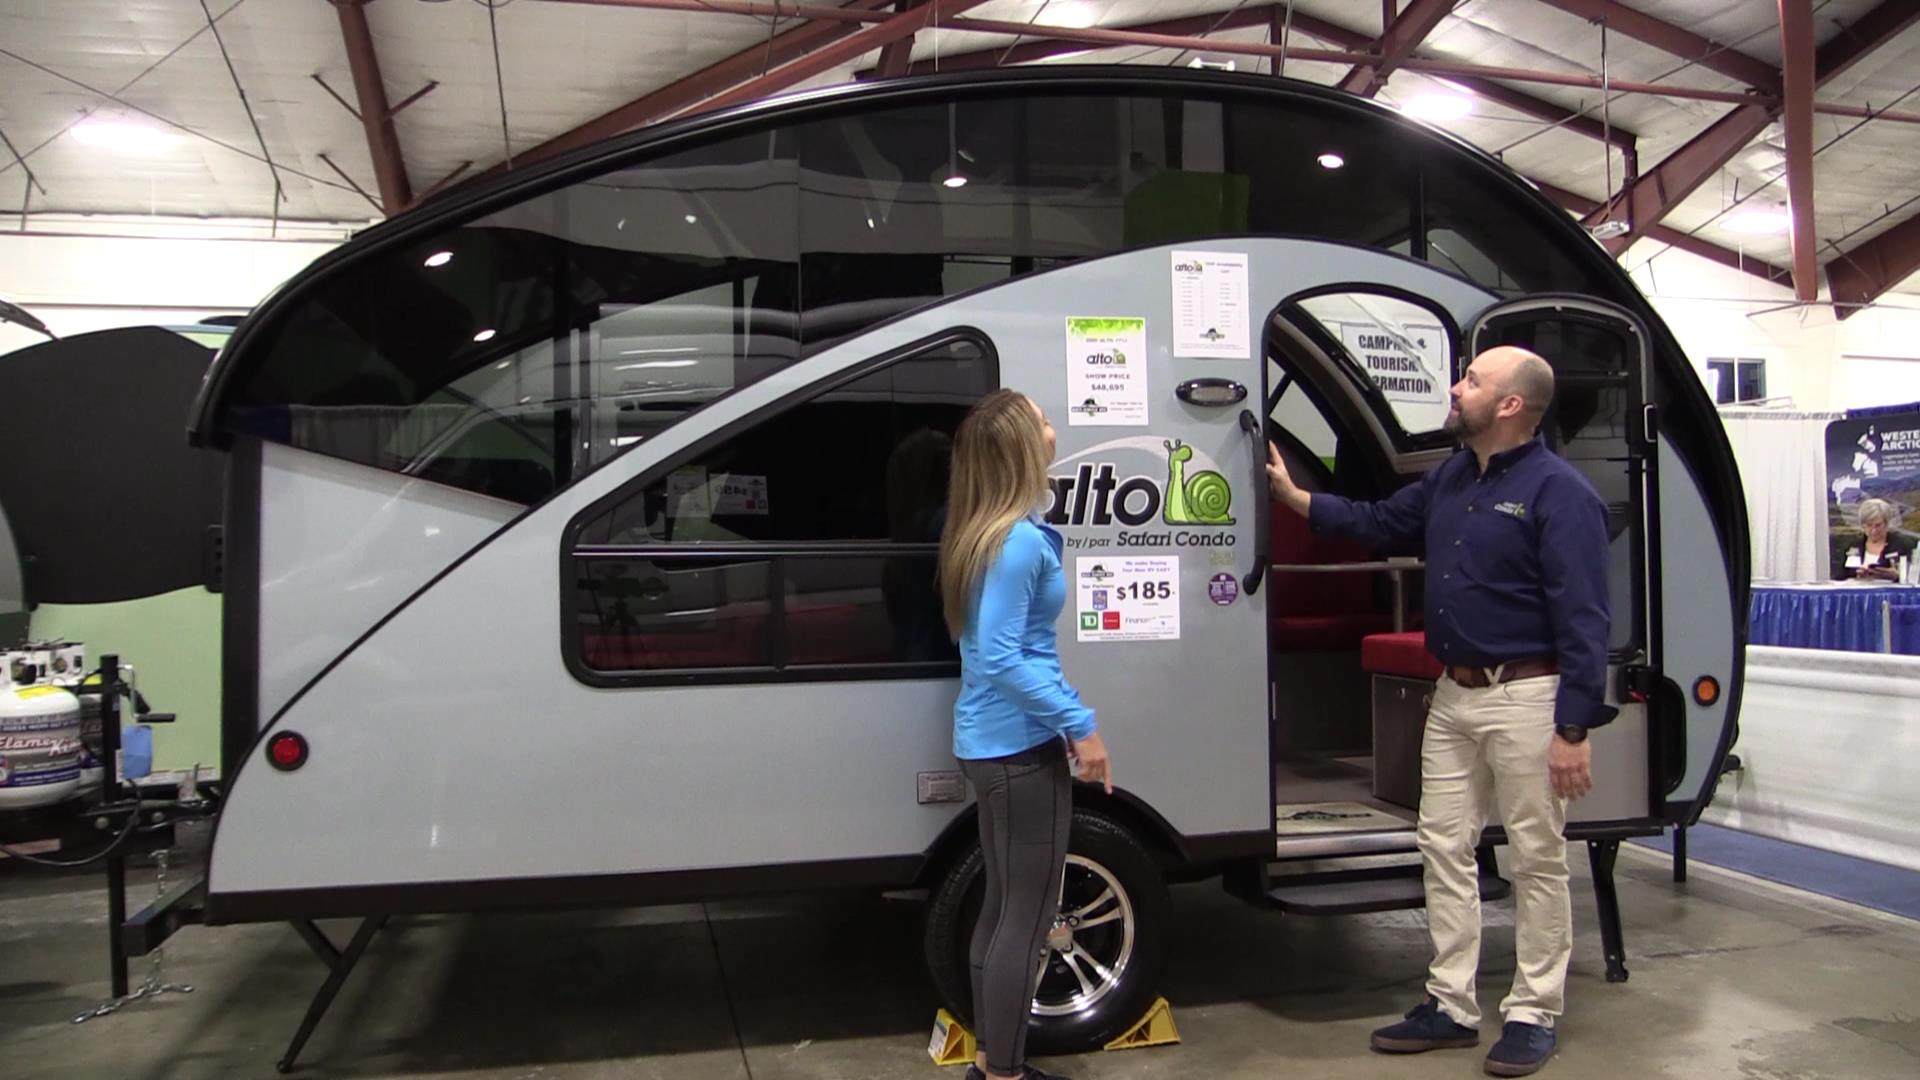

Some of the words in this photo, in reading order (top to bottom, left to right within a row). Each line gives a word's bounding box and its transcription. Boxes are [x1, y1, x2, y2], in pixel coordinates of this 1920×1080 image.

[1358, 334, 1404, 352] CAMP
[1086, 352, 1113, 365] alto
[1066, 536, 1111, 549] by/par
[1116, 531, 1171, 546] Safari
[1175, 531, 1236, 546] Condo
[1116, 581, 1171, 600] $185
[1082, 615, 1097, 627] TD
